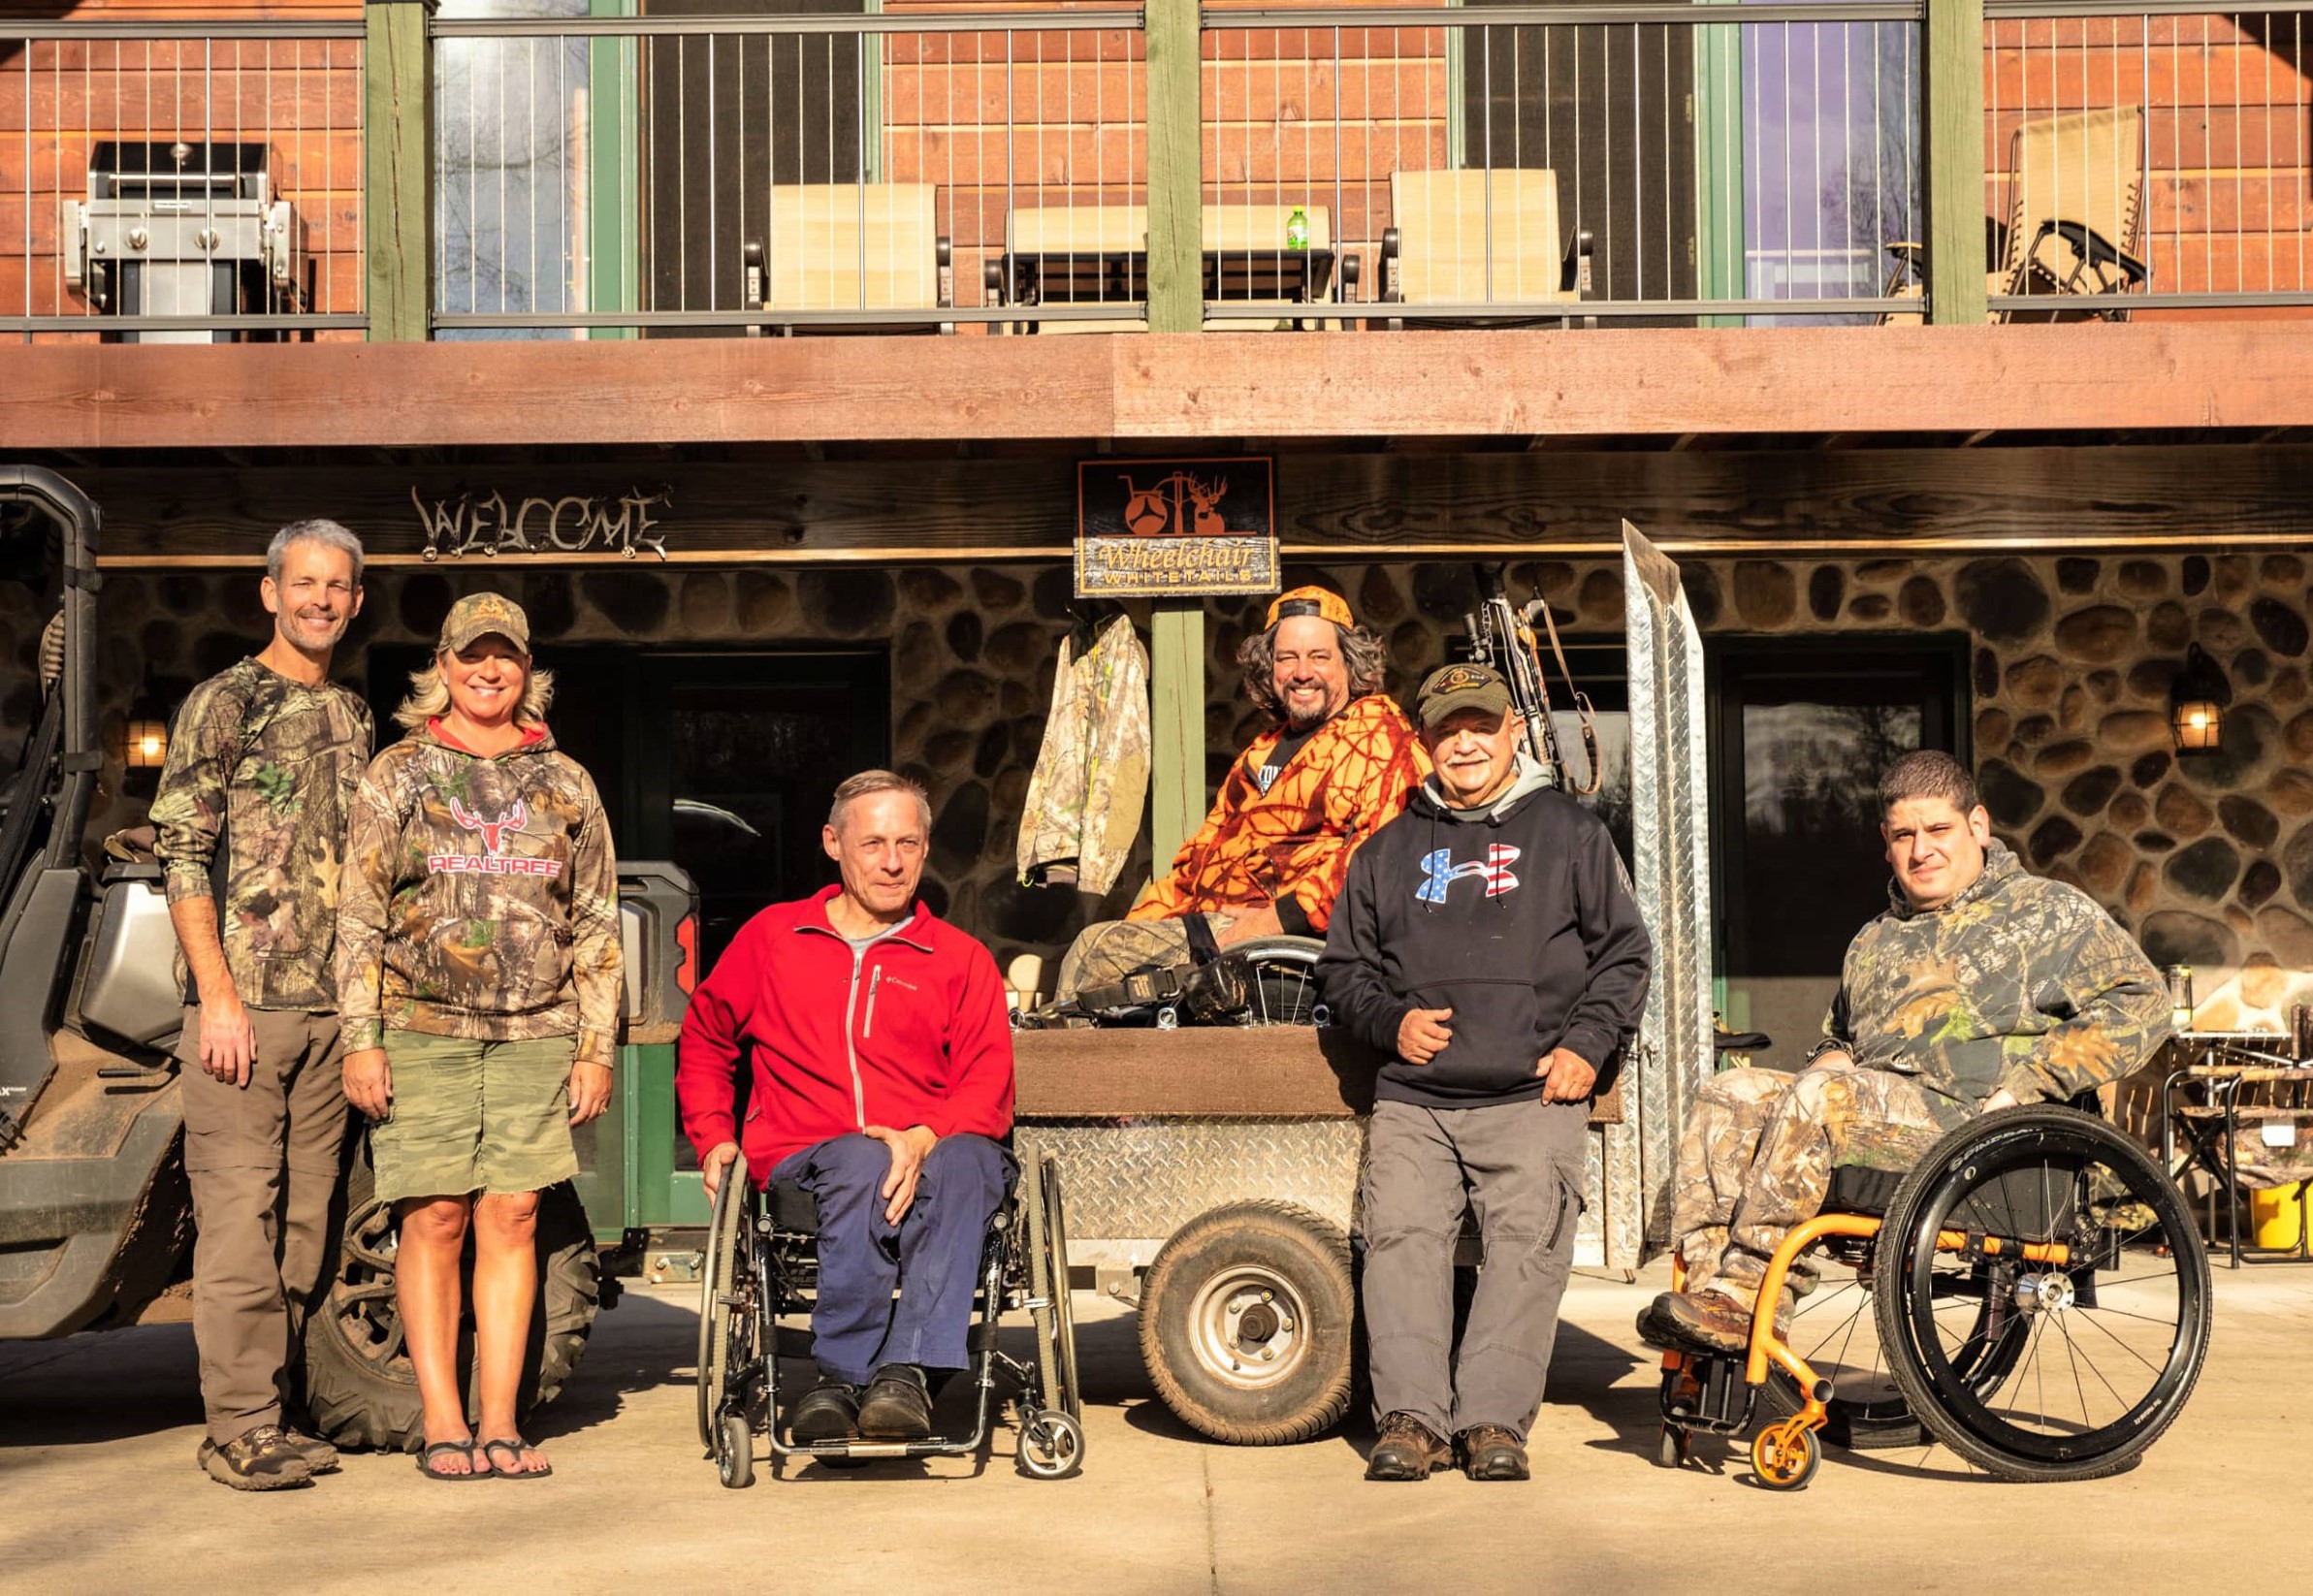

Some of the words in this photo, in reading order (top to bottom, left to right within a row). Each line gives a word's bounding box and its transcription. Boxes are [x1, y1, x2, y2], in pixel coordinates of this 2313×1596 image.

[411, 485, 672, 559] WELCOME
[1098, 538, 1252, 569] Wheelchair
[1104, 569, 1252, 584] WHITETAILS
[428, 855, 562, 878] REALTREE
